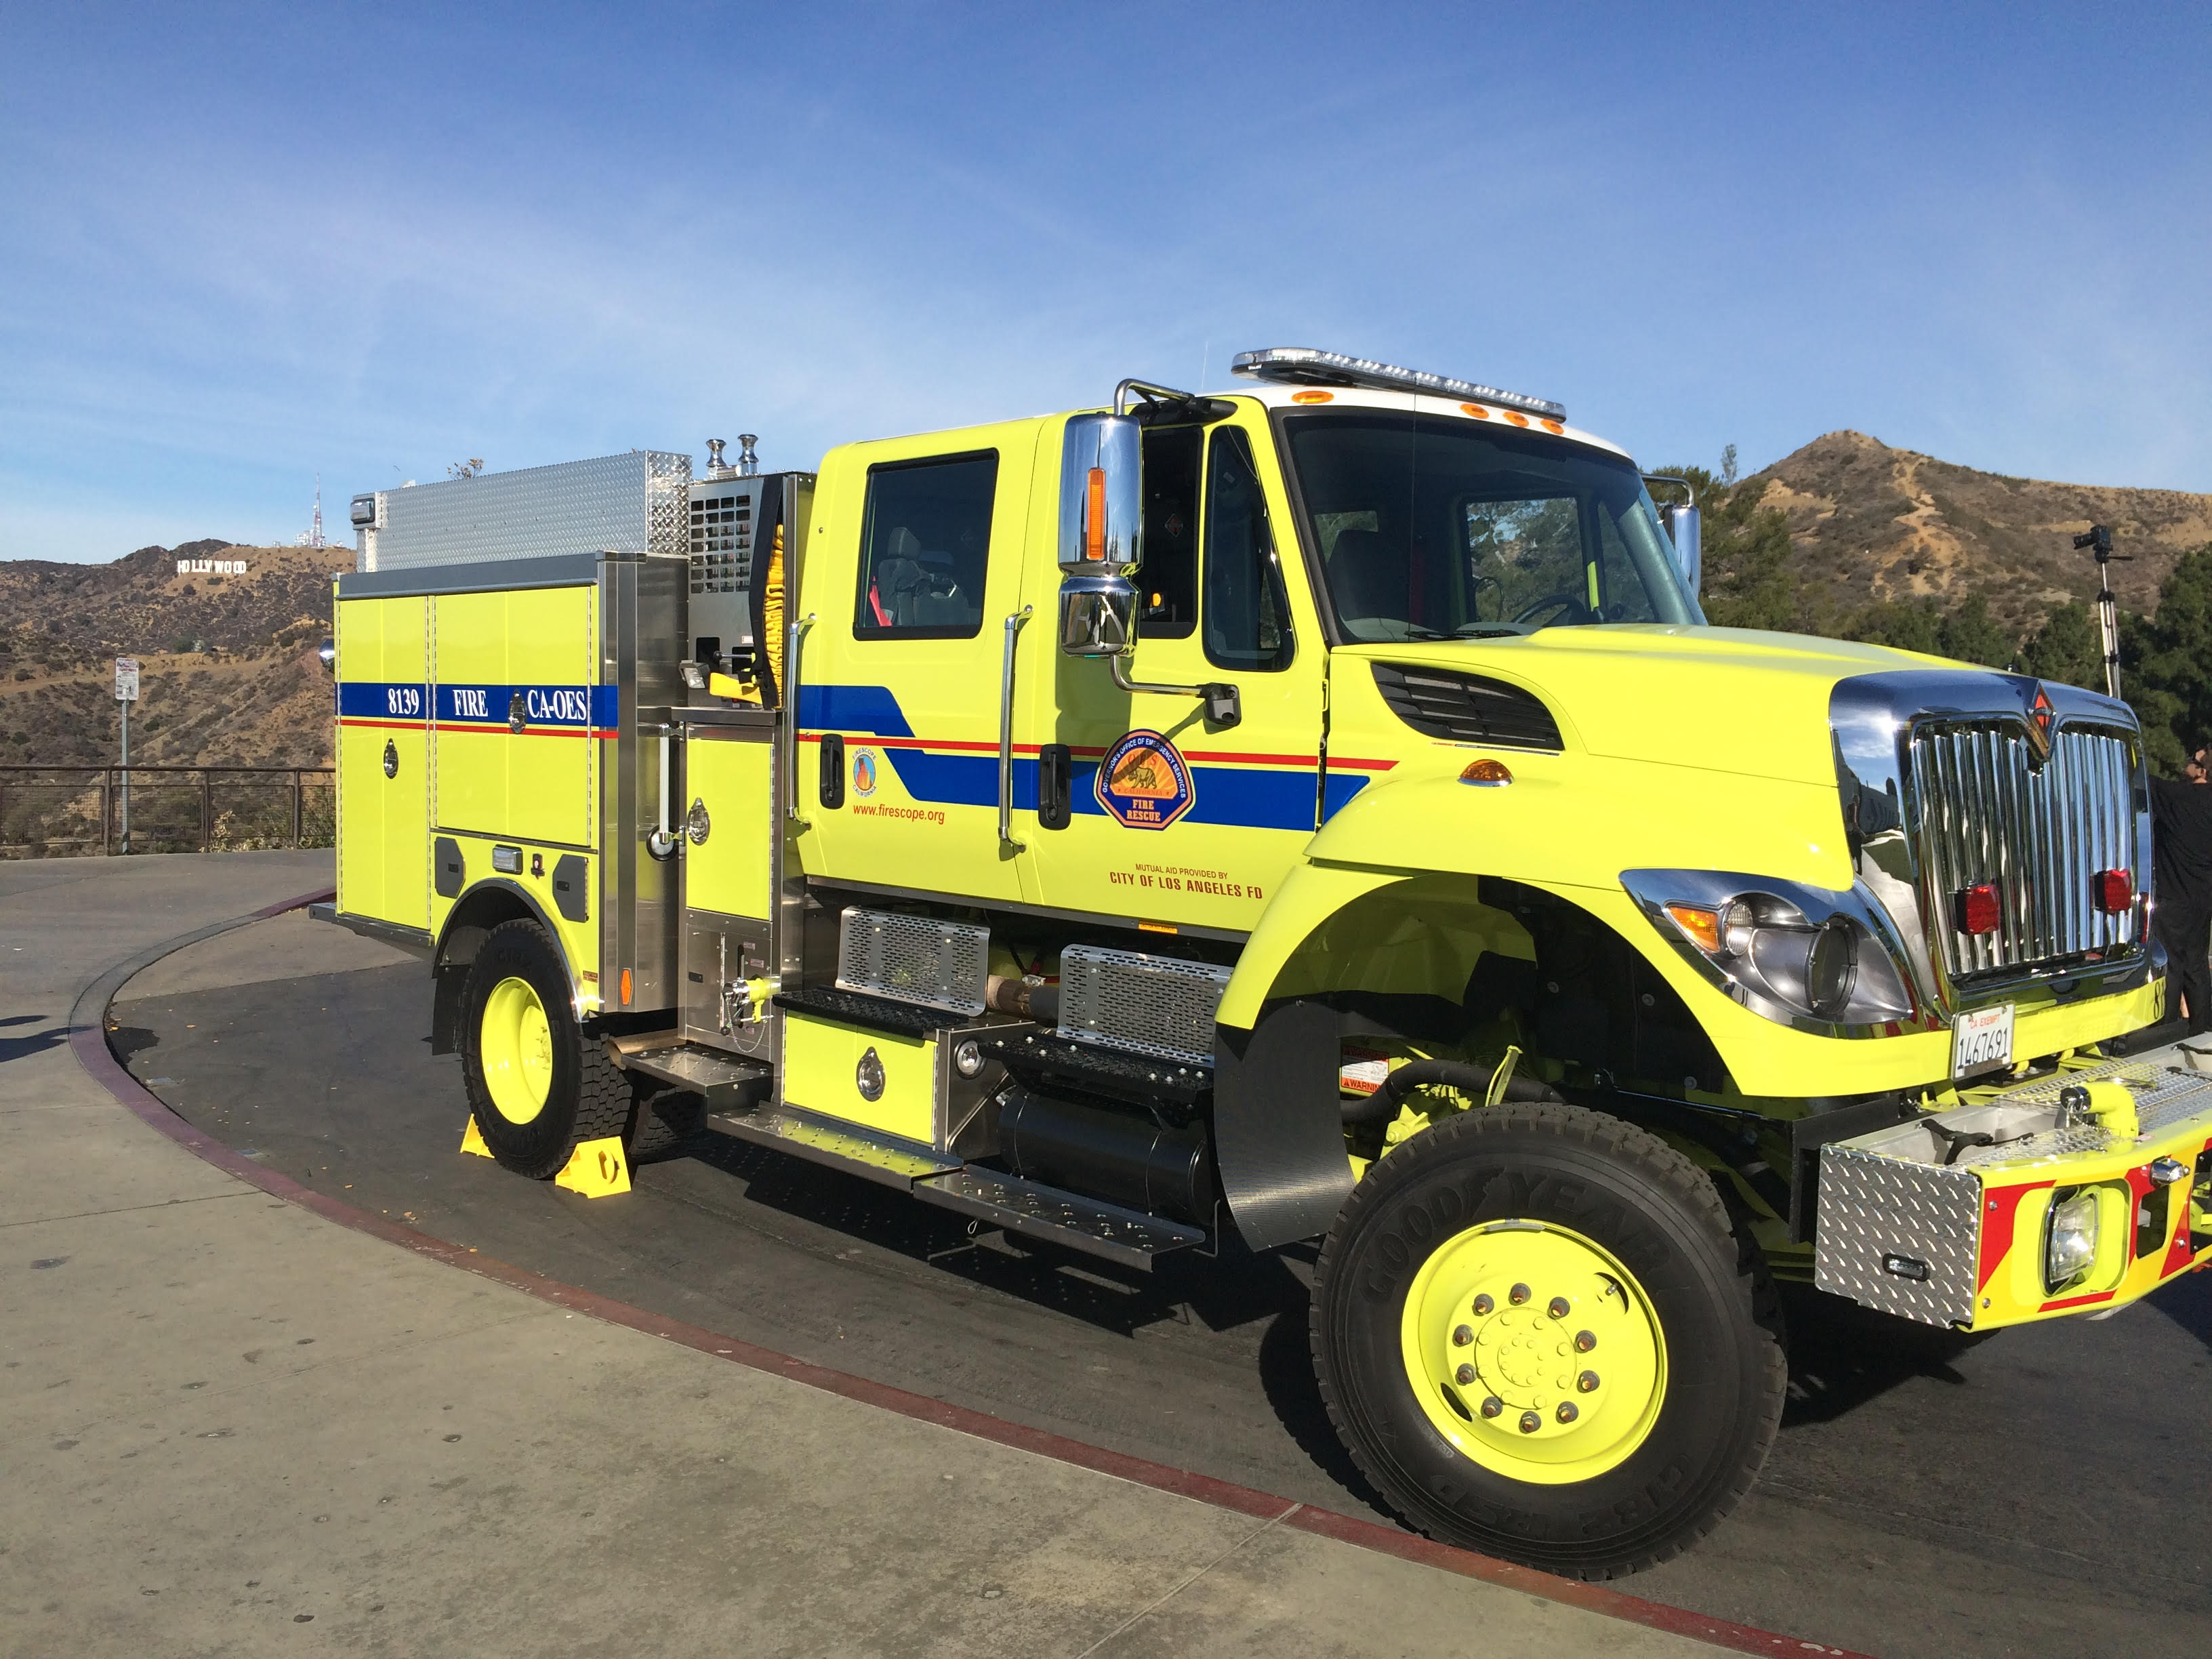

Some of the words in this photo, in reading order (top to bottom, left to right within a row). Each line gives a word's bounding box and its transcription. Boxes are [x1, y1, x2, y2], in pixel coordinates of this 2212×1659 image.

[178, 560, 247, 574] HOLLYWOOD
[388, 688, 419, 715] 8139
[453, 689, 488, 717] FIRE
[527, 689, 587, 720] CA-OES
[852, 747, 876, 760] FIRESCOPE
[1120, 738, 1136, 754] OFFICE
[1145, 738, 1175, 764] EMERGENCY
[1172, 763, 1186, 798] SERVICES
[1124, 788, 1163, 796] CALIFORNIA
[1132, 799, 1154, 810] FIRE
[853, 804, 945, 825] www.firescope.org
[1126, 810, 1161, 822] RESCUE
[1135, 863, 1164, 874] MUTUAL
[1166, 866, 1178, 875] AID
[1179, 867, 1216, 879] PROVIDED
[1218, 872, 1228, 880] BY
[1109, 872, 1134, 885] CITY
[1140, 874, 1153, 887] OF
[1158, 876, 1181, 890] LOS
[1187, 880, 1242, 897] ANGELES
[1247, 886, 1263, 899] FD
[1969, 1019, 1978, 1029] CA
[1980, 1014, 2001, 1027] EXEMPT
[1957, 1027, 2008, 1070] 1467691
[1359, 1166, 1671, 1304] GOODYEAR
